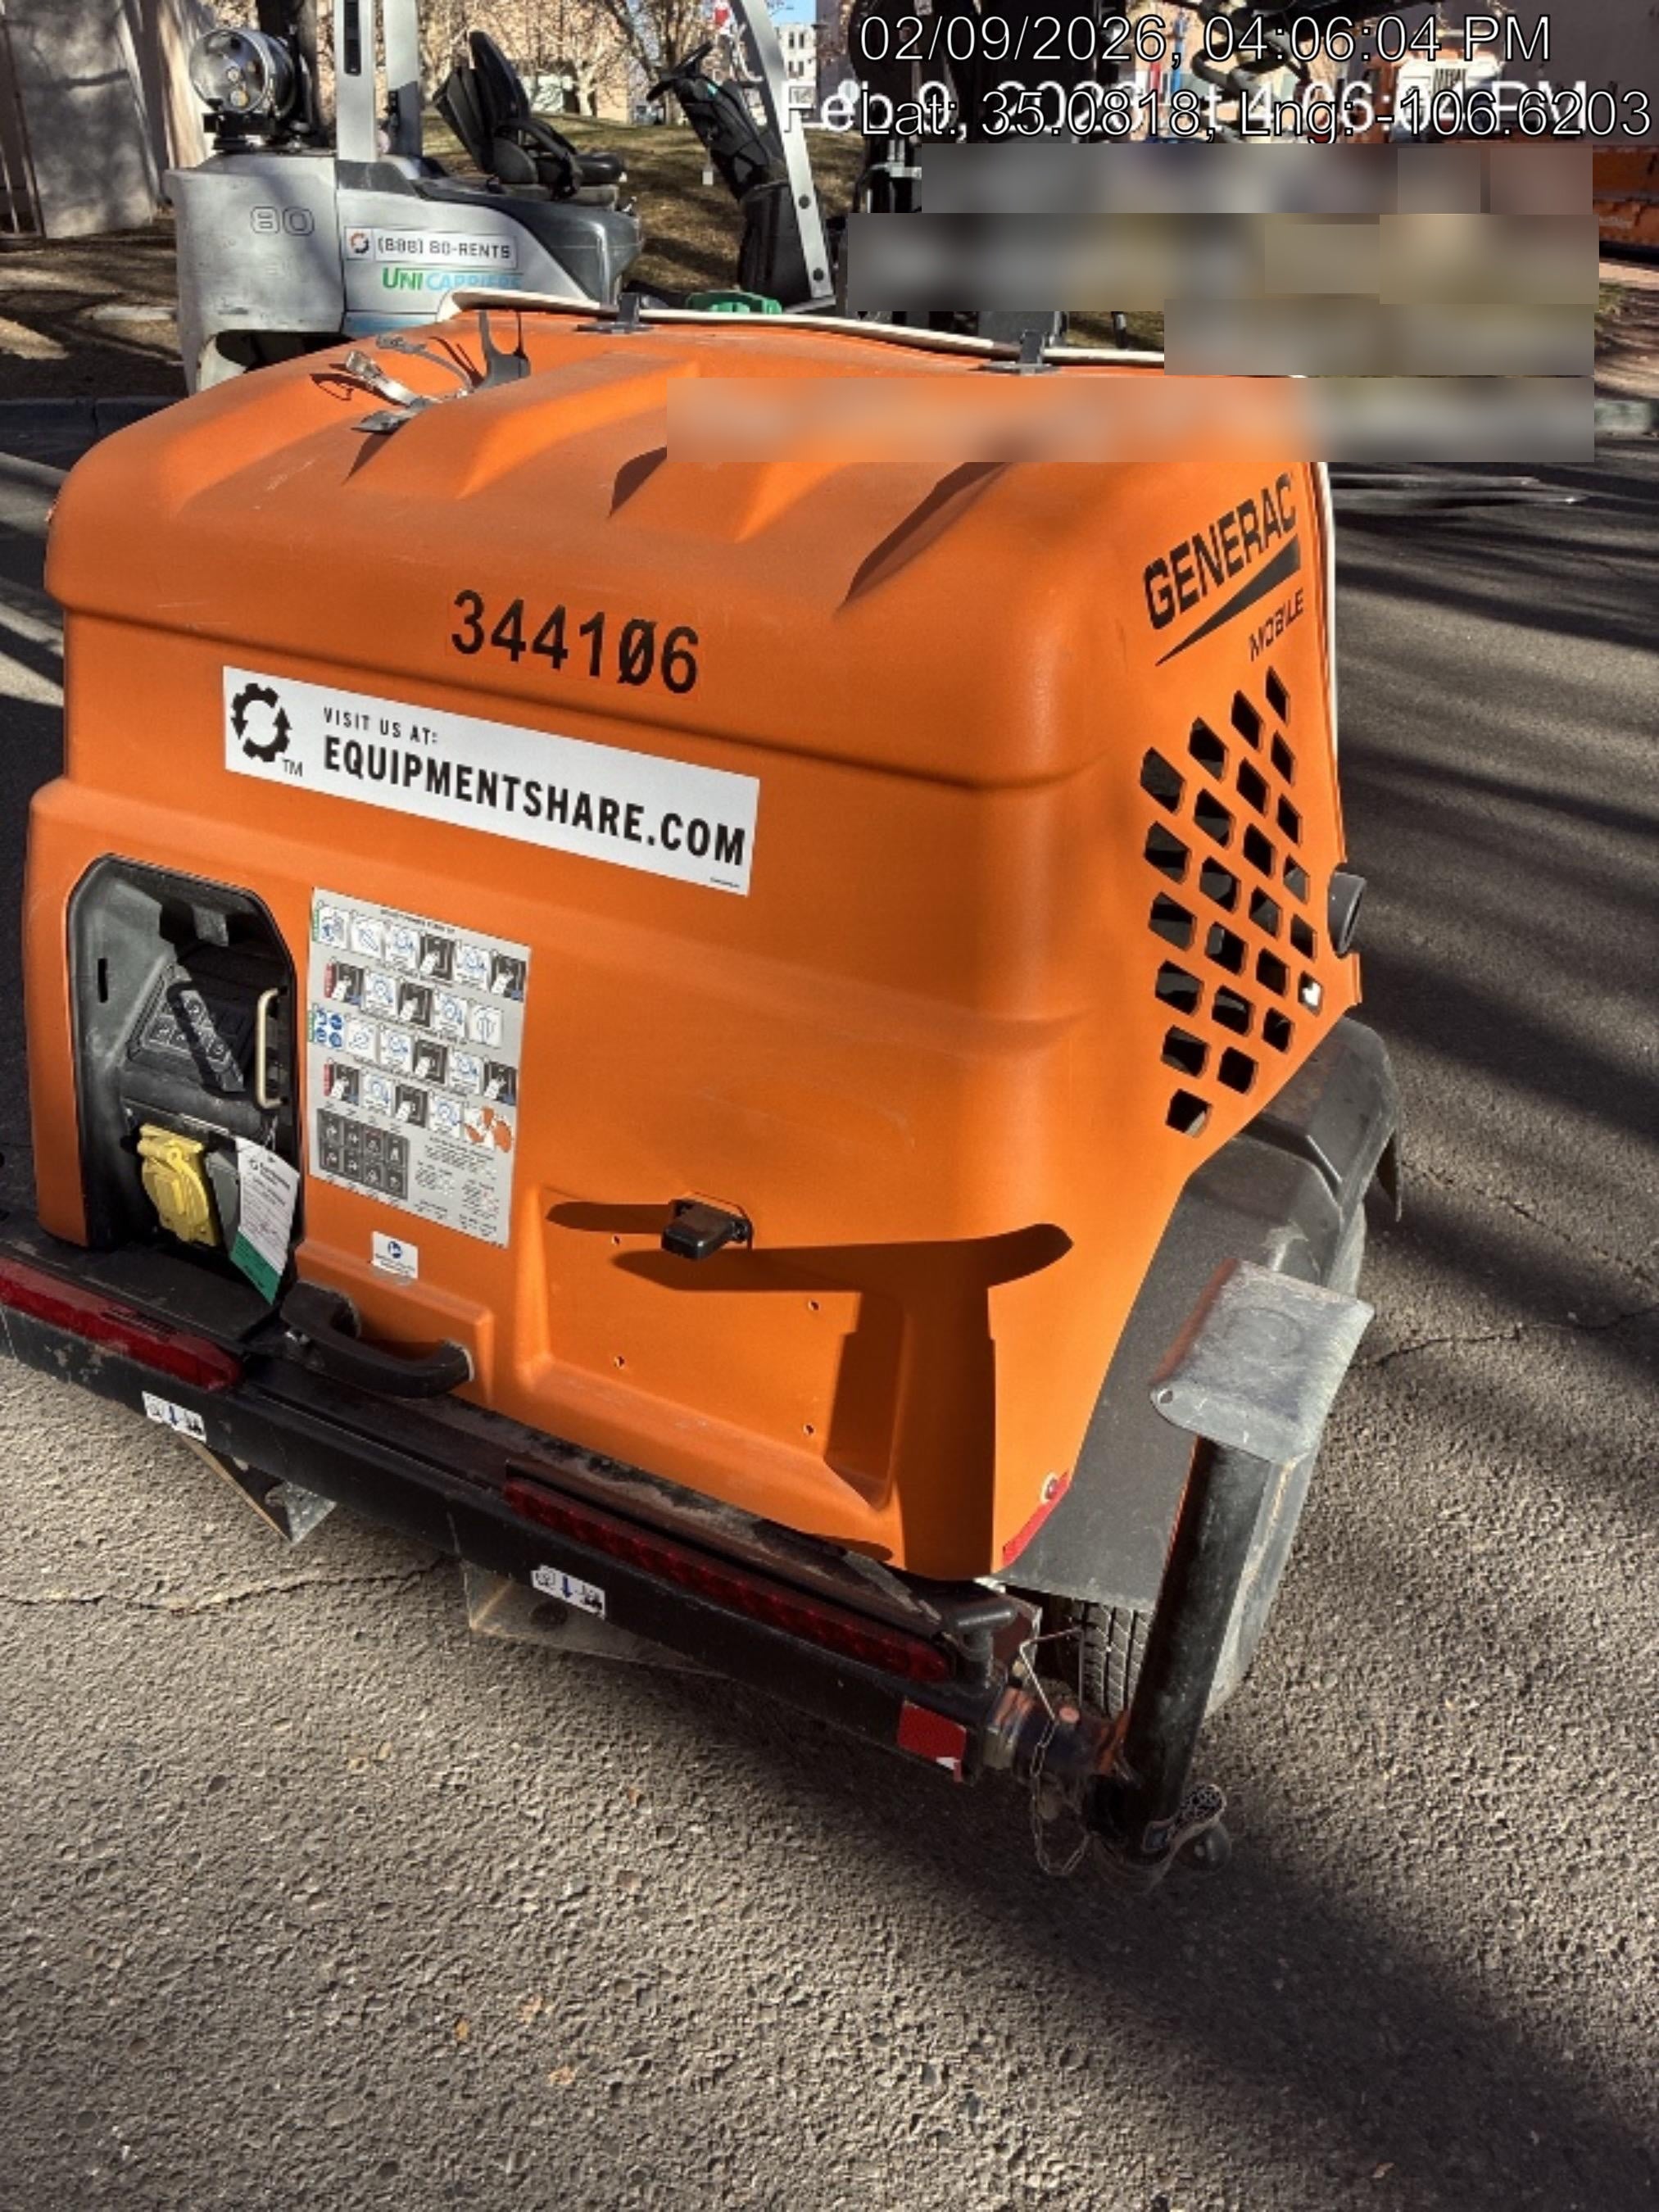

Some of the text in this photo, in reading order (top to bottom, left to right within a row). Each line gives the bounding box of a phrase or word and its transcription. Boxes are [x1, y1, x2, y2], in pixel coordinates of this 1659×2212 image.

[250, 206, 315, 236] 80
[378, 237, 511, 260] (888) 80-RENTS
[1143, 473, 1298, 630] GENERAC
[450, 589, 700, 695] 344106
[1249, 588, 1304, 662] MOBILE
[323, 706, 438, 746] VISIT US AT:
[324, 735, 744, 866] EQUIPMENTSHARE.COM
